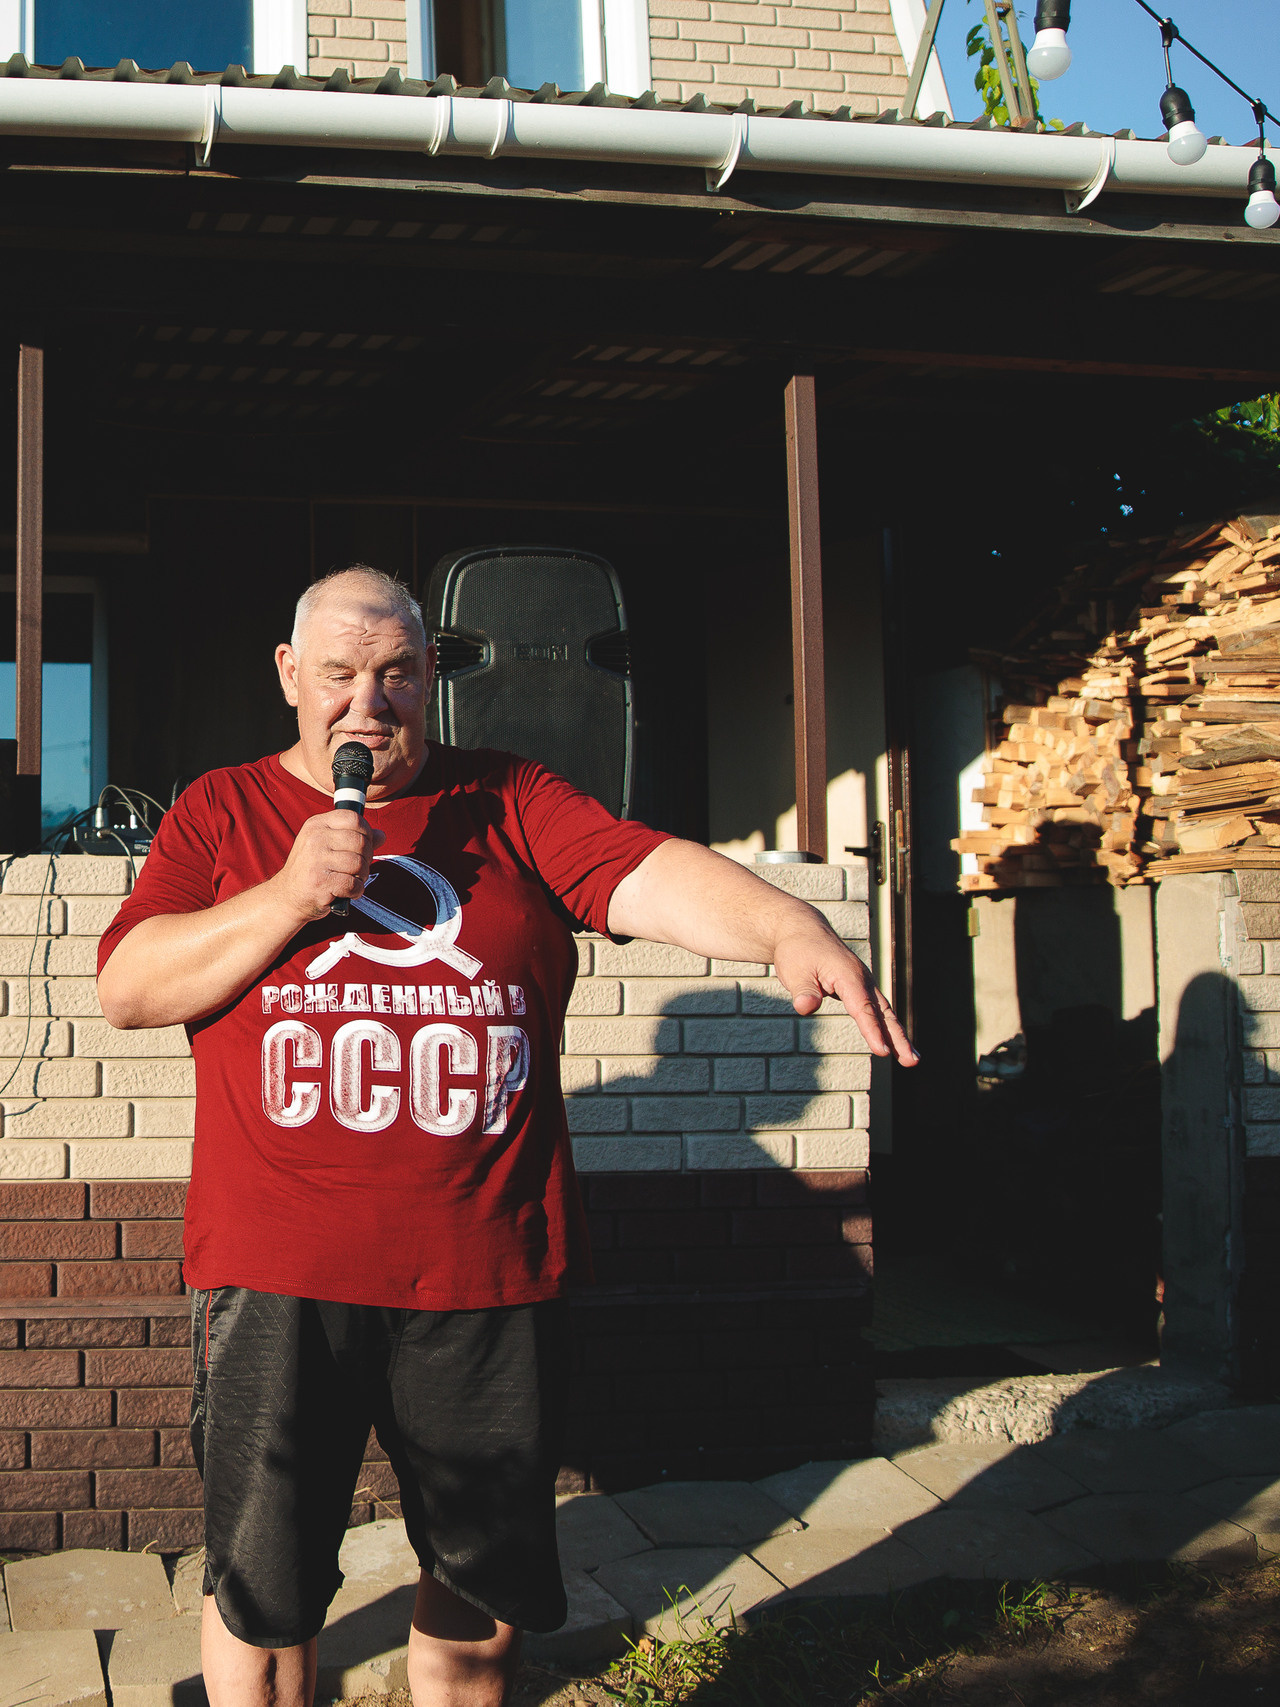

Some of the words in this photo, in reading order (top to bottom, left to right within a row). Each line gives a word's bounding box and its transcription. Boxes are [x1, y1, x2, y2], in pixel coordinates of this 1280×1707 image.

[262, 980, 504, 1016] РОЖДЕННЫЙ
[508, 984, 527, 1016] В
[262, 1020, 530, 1137] СССР
